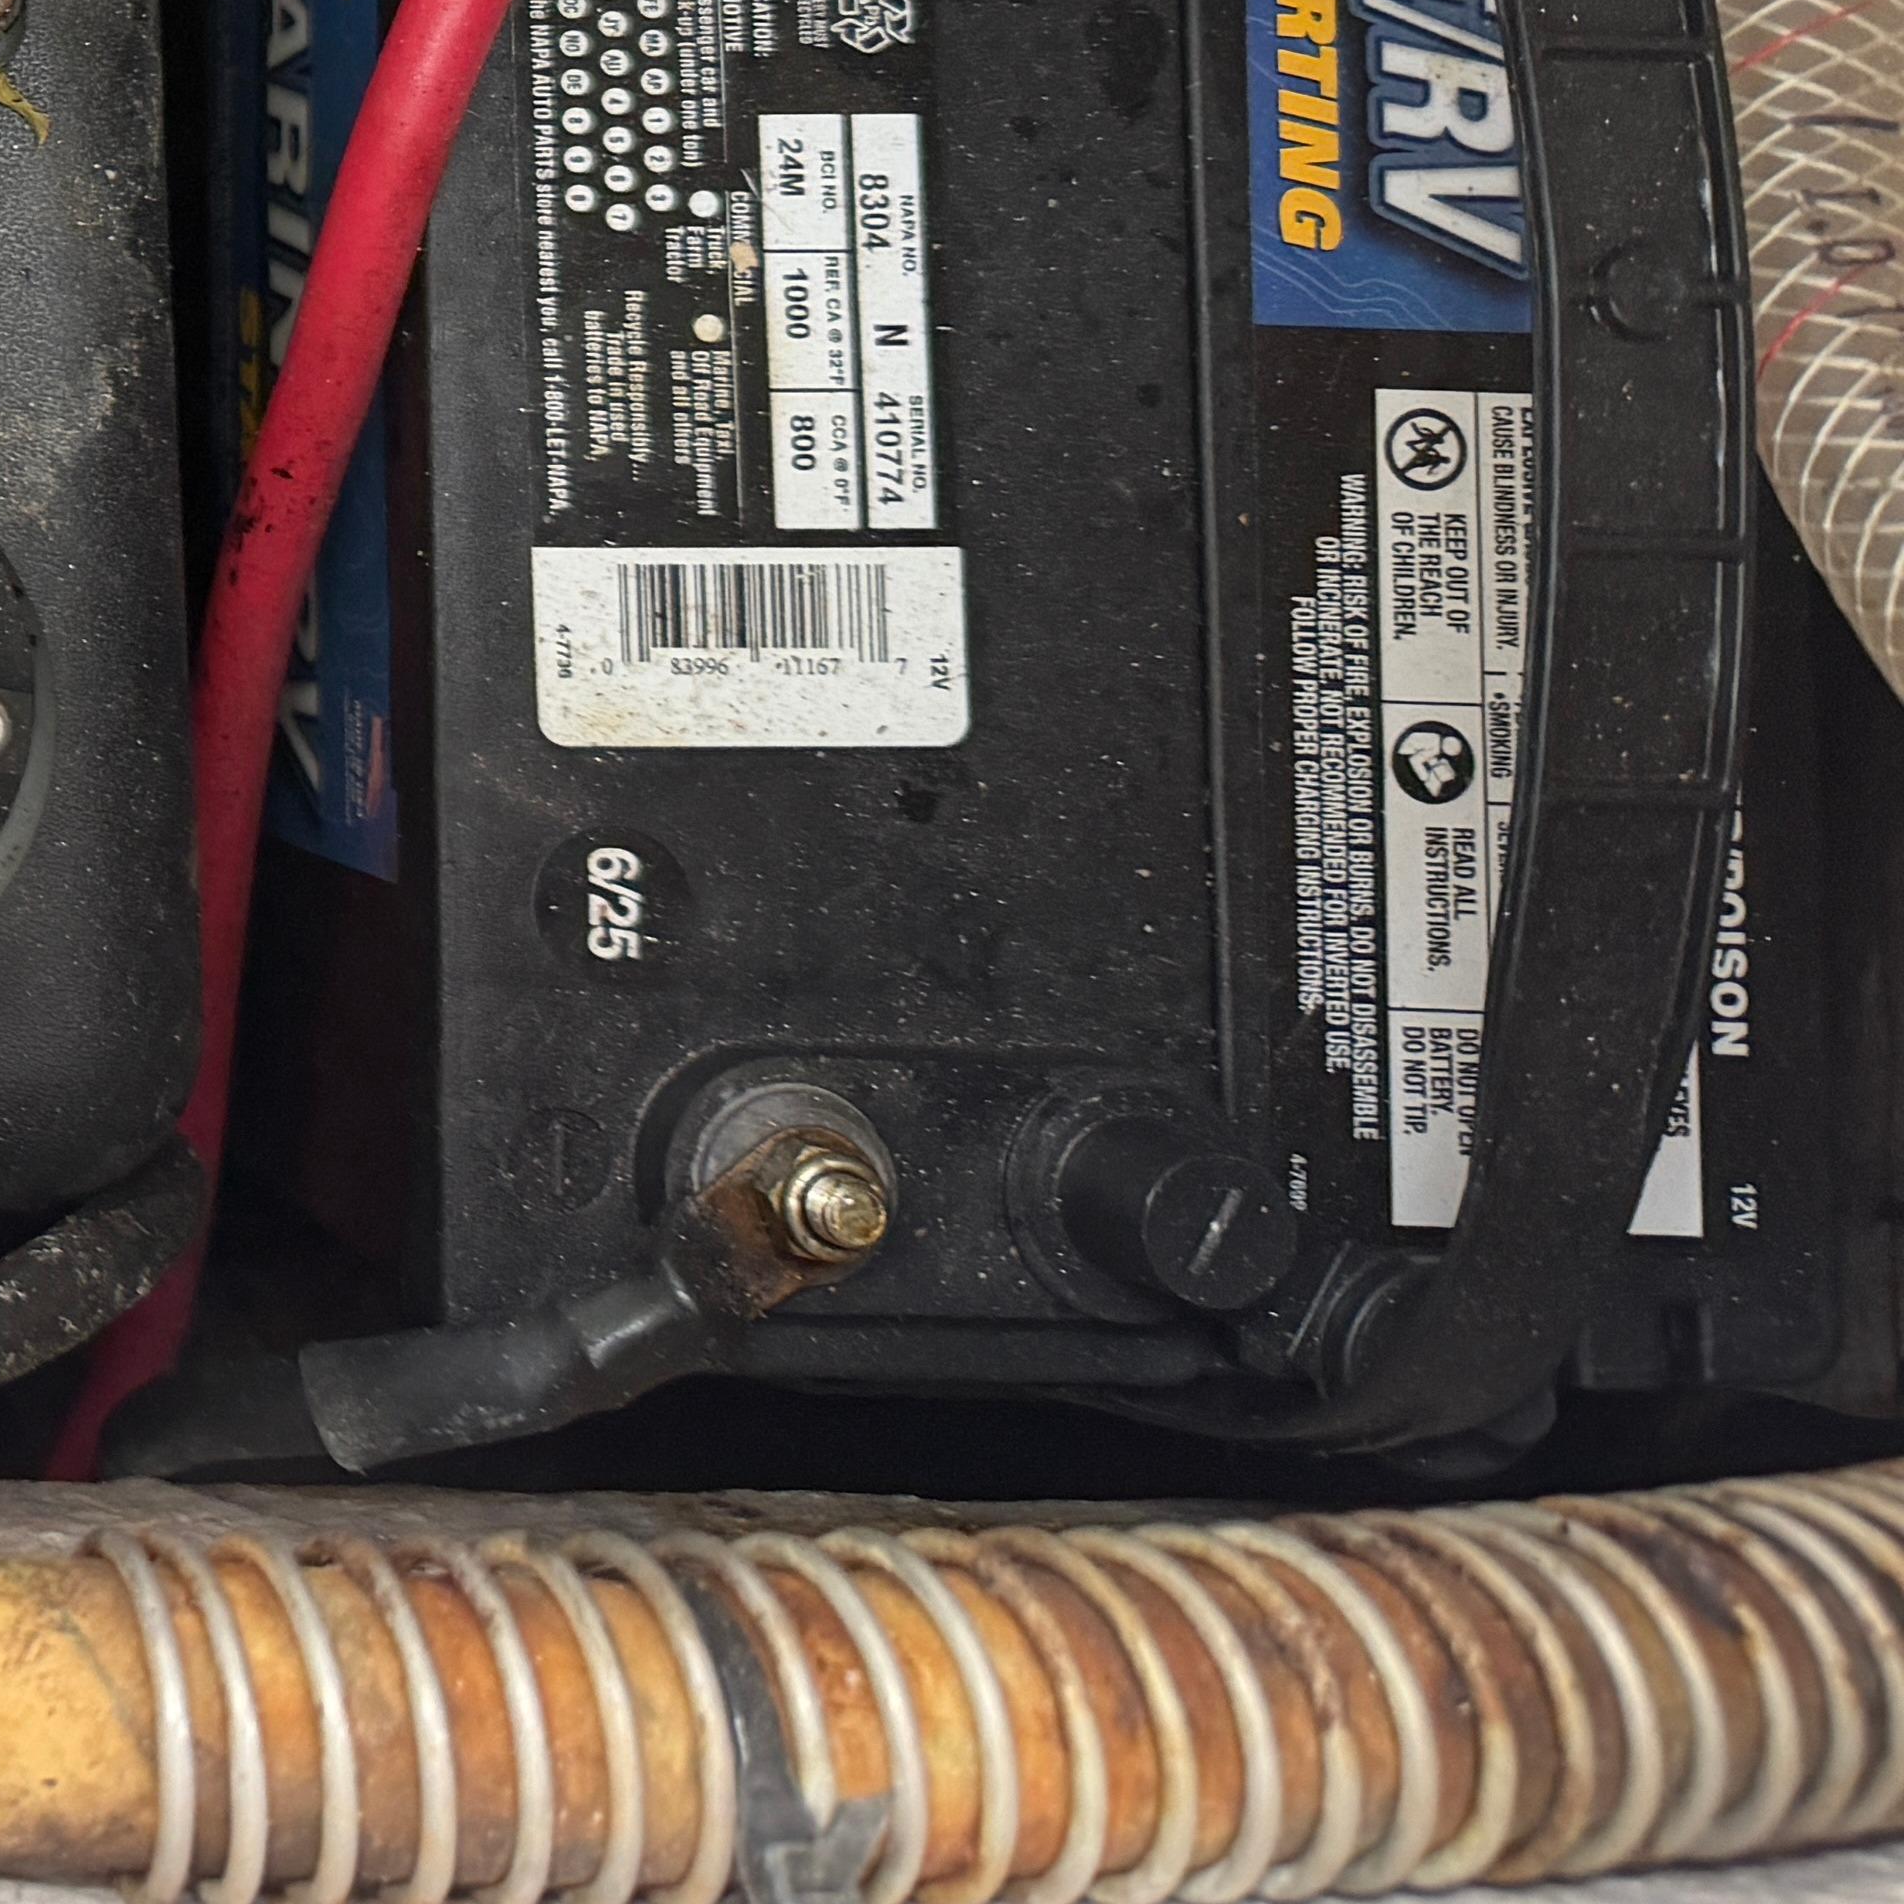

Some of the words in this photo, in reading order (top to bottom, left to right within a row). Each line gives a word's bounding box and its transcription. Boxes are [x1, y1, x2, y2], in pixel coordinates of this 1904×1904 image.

[564, 35, 580, 52] NO
[604, 16, 620, 34] JY
[645, 34, 660, 52] MA
[530, 24, 551, 70] NAPA
[606, 54, 622, 72] AU
[566, 74, 582, 90] DE
[677, 42, 700, 95] (under
[700, 67, 718, 92] car
[532, 74, 552, 120] AUTO
[680, 100, 698, 130] one
[702, 98, 722, 128] and
[534, 124, 554, 180] PARTS
[680, 134, 704, 168] ton)
[777, 136, 806, 196] 24M
[820, 150, 836, 179] BCI
[535, 184, 556, 226] store
[822, 184, 837, 214] NO.
[858, 173, 892, 252] 8304
[900, 195, 915, 241] NAPA
[537, 230, 557, 293] nearest
[664, 226, 684, 284] Tractor
[686, 226, 704, 269] Farm
[704, 226, 724, 274] Truck,
[730, 190, 753, 306] COMMCIAL
[901, 246, 918, 277] NO.
[536, 296, 558, 332] you,
[623, 290, 648, 356] Recycle
[782, 267, 811, 340] 1000
[826, 298, 842, 322] CA
[541, 338, 564, 369] call
[584, 310, 605, 383] batteries
[606, 331, 624, 376] Trade
[829, 328, 843, 344] @
[874, 324, 910, 347] N
[669, 350, 688, 382] and
[692, 350, 712, 374] Off
[711, 350, 734, 414] Marine,
[586, 388, 605, 405] to
[608, 382, 624, 396] in
[671, 385, 690, 408] all
[692, 378, 713, 419] Road
[610, 402, 626, 442] used
[627, 360, 652, 482] Responsibly...
[673, 412, 692, 465] others
[714, 419, 736, 460] Taxi,
[830, 414, 848, 452] CCA
[908, 395, 926, 458] SERIAL
[1492, 406, 1516, 458] CAUSE
[790, 414, 816, 472] 800
[874, 392, 905, 506] 410774
[691, 426, 718, 516] Equipment
[833, 457, 848, 473] @
[912, 463, 928, 494] NO.
[1340, 474, 1366, 568] WARNING:
[1391, 512, 1414, 536] OF
[1418, 512, 1441, 549] THE
[1492, 464, 1518, 556] BLINDNESS
[1314, 536, 1340, 562] OR
[1444, 513, 1469, 562] KEEP
[1418, 554, 1443, 618] REACH
[1445, 566, 1469, 604] OUT
[1496, 560, 1518, 583] OR
[1342, 575, 1368, 620] RISK
[1290, 596, 1318, 674] FOLLOW
[1344, 624, 1368, 649] OF
[1446, 609, 1470, 634] OF
[1496, 588, 1520, 650] INJURY.
[600, 658, 614, 675] 0
[670, 658, 728, 676] 83996
[782, 658, 840, 676] 11167
[896, 658, 908, 675] 7
[929, 653, 950, 691] 12V
[1343, 654, 1370, 701] FIRE,
[1292, 679, 1320, 754] PROPER
[1320, 689, 1344, 728] NOT
[1344, 706, 1372, 812] EXPLOSION
[1294, 760, 1322, 859] CHARGING
[1320, 733, 1348, 883] RECOMMENDED
[1348, 818, 1374, 845] OR
[1452, 828, 1476, 879] READ
[586, 846, 644, 961] 6/25
[1324, 888, 1348, 926] FOR
[1424, 826, 1450, 972] INSTRUCTIONS.
[1452, 884, 1477, 921] ALL
[1350, 926, 1376, 954] DO
[1324, 932, 1350, 1025] INVERTED
[1350, 958, 1376, 999] NOT
[1324, 1030, 1351, 1074] USE.
[1402, 1026, 1426, 1054] DO
[1456, 1028, 1479, 1055] DO
[1352, 1002, 1380, 1140] DISASSEMBLE
[1403, 1059, 1427, 1099] NOT
[1429, 1028, 1452, 1116] BATTERY.
[1456, 1062, 1480, 1102] NOT
[1404, 1103, 1428, 1135] TIP.
[1729, 1183, 1759, 1230] 12V
